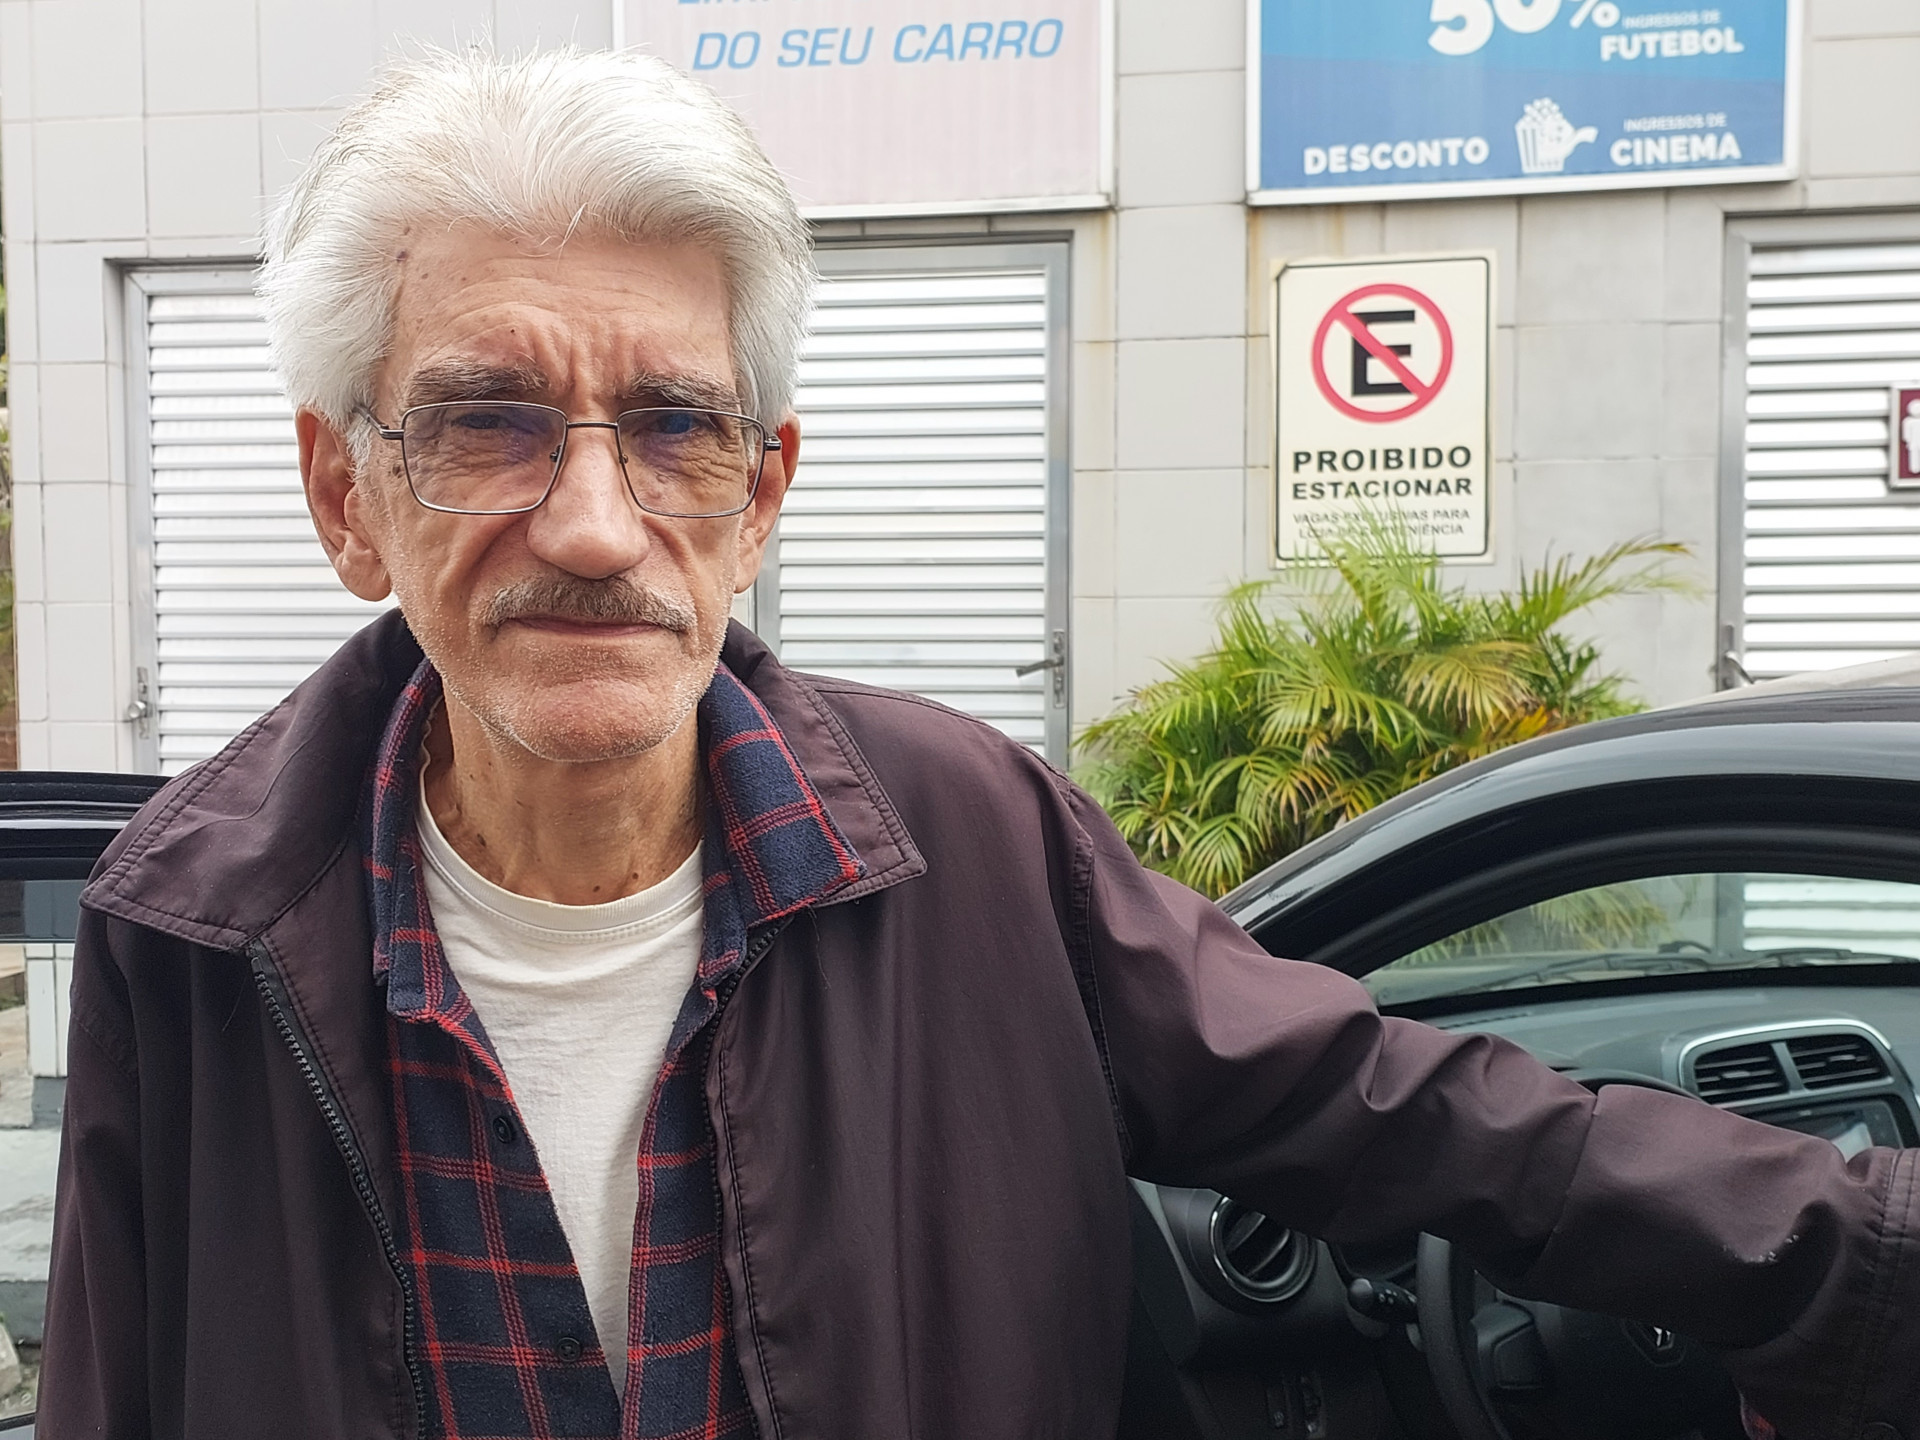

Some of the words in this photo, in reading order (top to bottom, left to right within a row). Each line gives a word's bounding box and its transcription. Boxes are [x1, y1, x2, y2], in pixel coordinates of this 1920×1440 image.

[1622, 12, 1699, 29] INGRESSOS
[1701, 10, 1721, 24] DE
[694, 32, 760, 70] DO
[778, 28, 873, 67] SEU
[893, 19, 1063, 63] CARRO
[1600, 26, 1745, 61] FUTEBOL
[1623, 114, 1704, 132] INGRESSOS
[1706, 112, 1727, 128] DE
[1303, 136, 1490, 175] DESCONTO
[1610, 132, 1743, 166] CINEMA
[1292, 446, 1472, 473] PROIBIDO
[1292, 478, 1472, 500] ESTACIONAR
[1293, 511, 1340, 524] VAGAS
[1432, 508, 1471, 520] PARA
